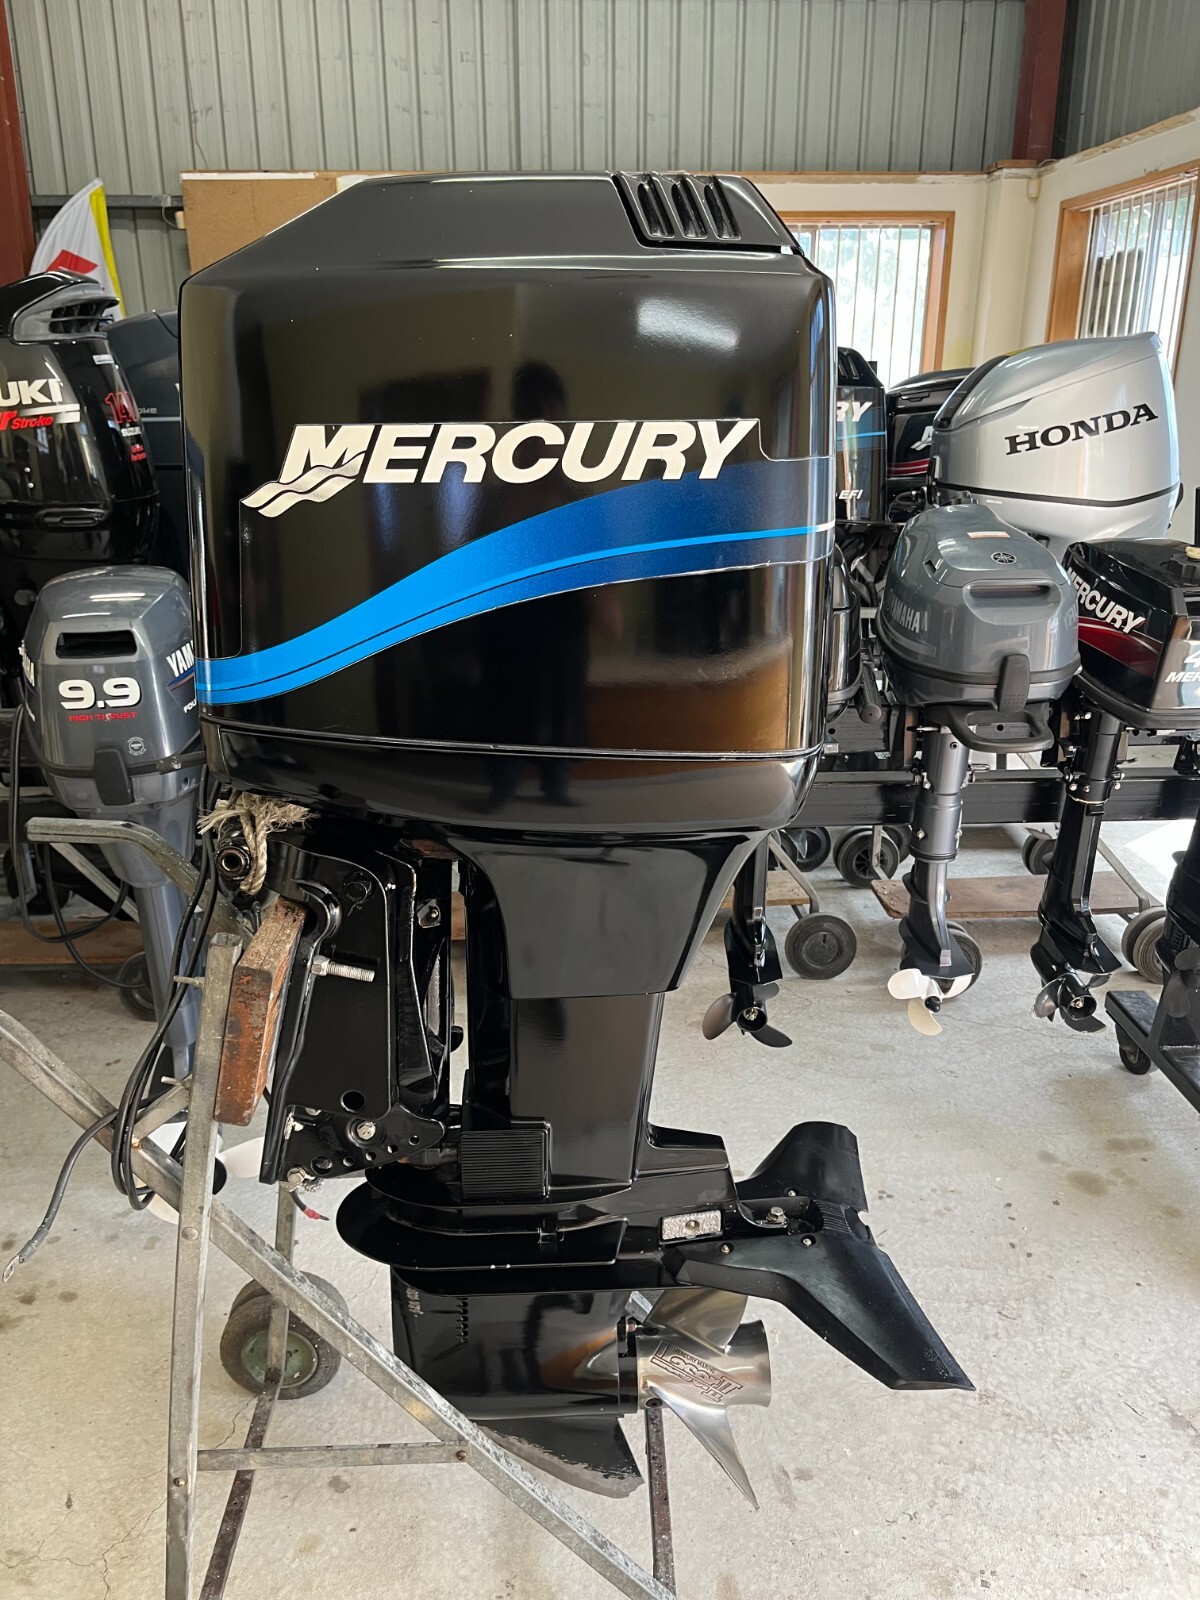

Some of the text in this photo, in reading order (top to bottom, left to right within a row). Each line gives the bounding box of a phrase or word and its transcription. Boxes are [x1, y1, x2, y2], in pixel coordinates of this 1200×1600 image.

[11, 415, 54, 430] Stroke
[1005, 403, 1159, 455] HONDA
[278, 419, 760, 486] MERCURY
[838, 489, 864, 500] EFI
[58, 677, 141, 710] 9.9
[68, 713, 93, 722] HIGH
